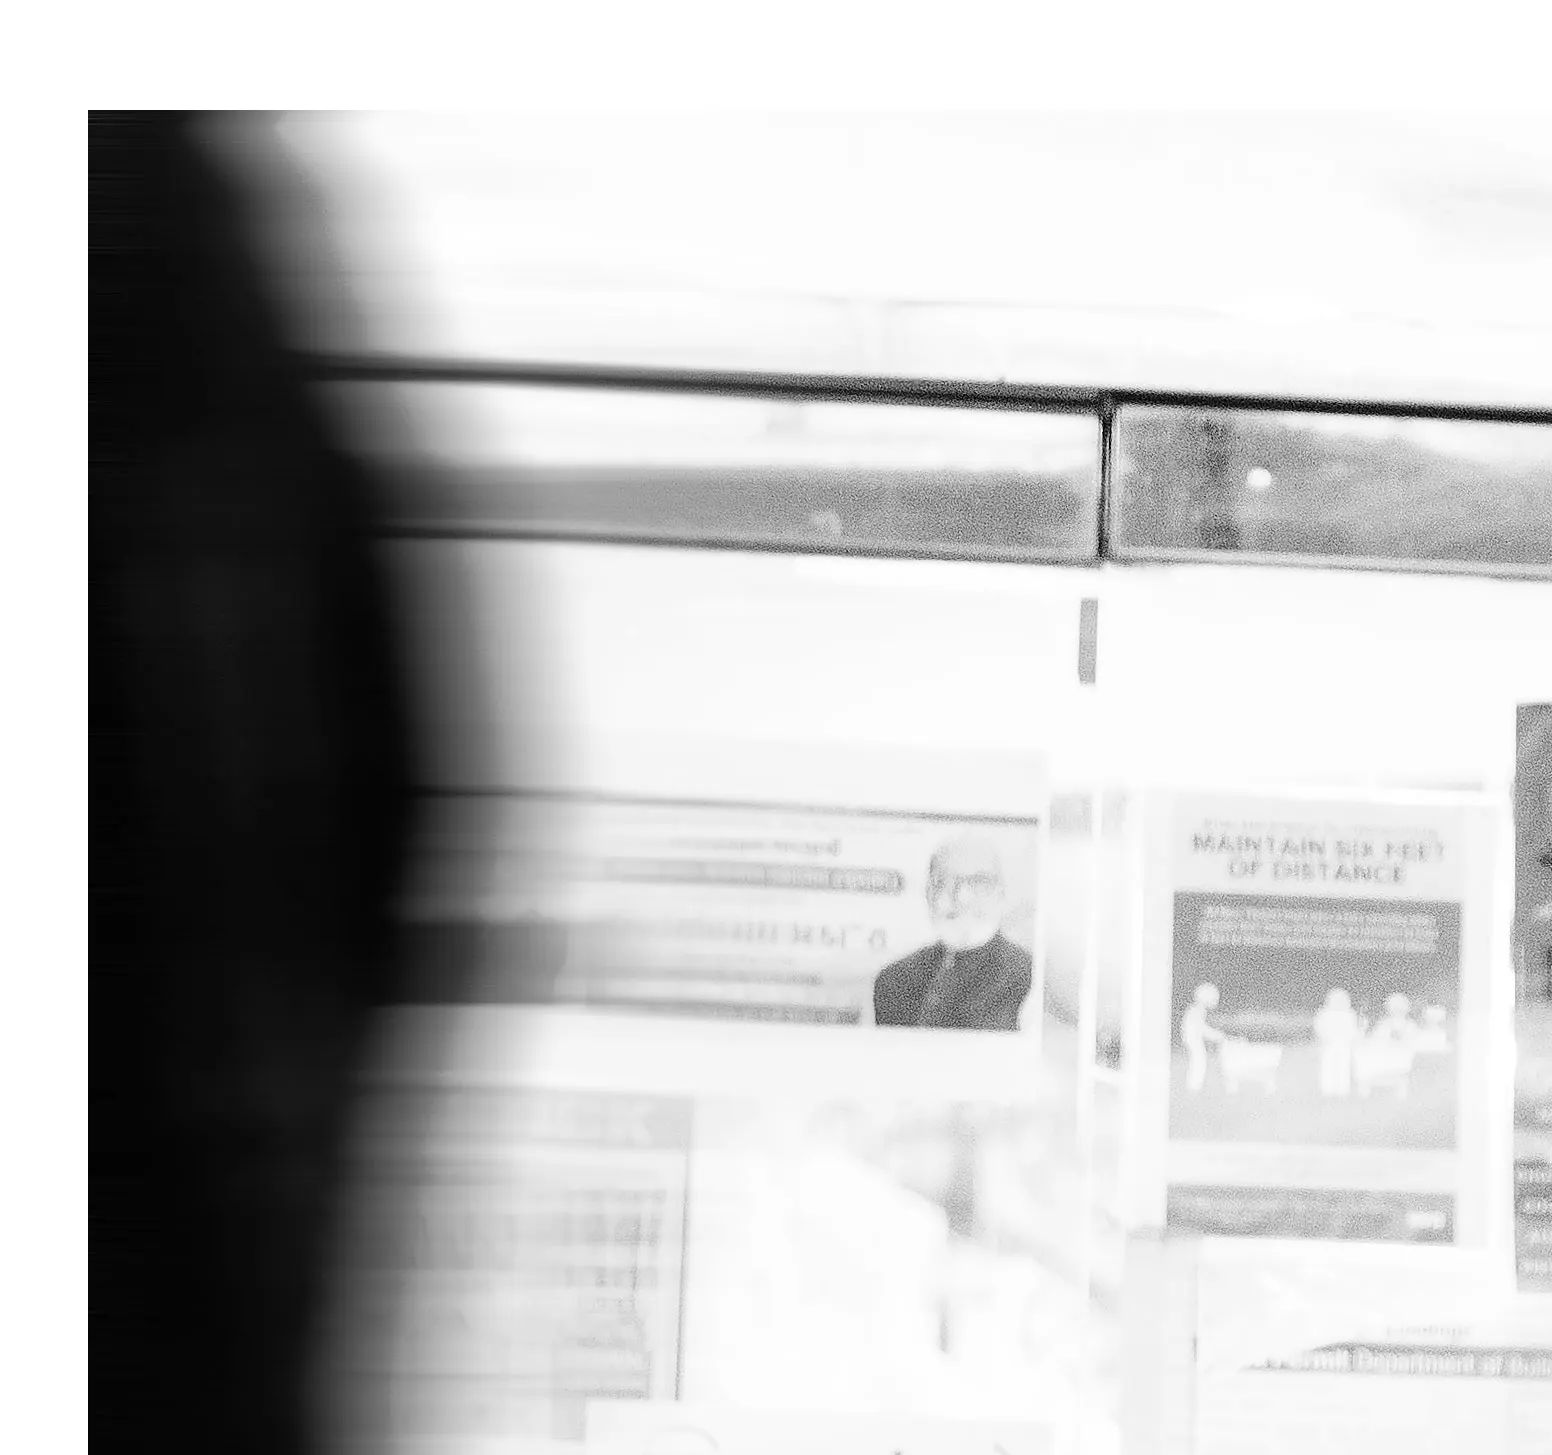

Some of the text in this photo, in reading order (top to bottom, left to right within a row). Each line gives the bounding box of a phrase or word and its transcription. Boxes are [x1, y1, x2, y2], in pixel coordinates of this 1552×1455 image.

[1192, 834, 1446, 861] MAINTAIN SIX FEET
[1228, 860, 1406, 885] OF DISTANCE
